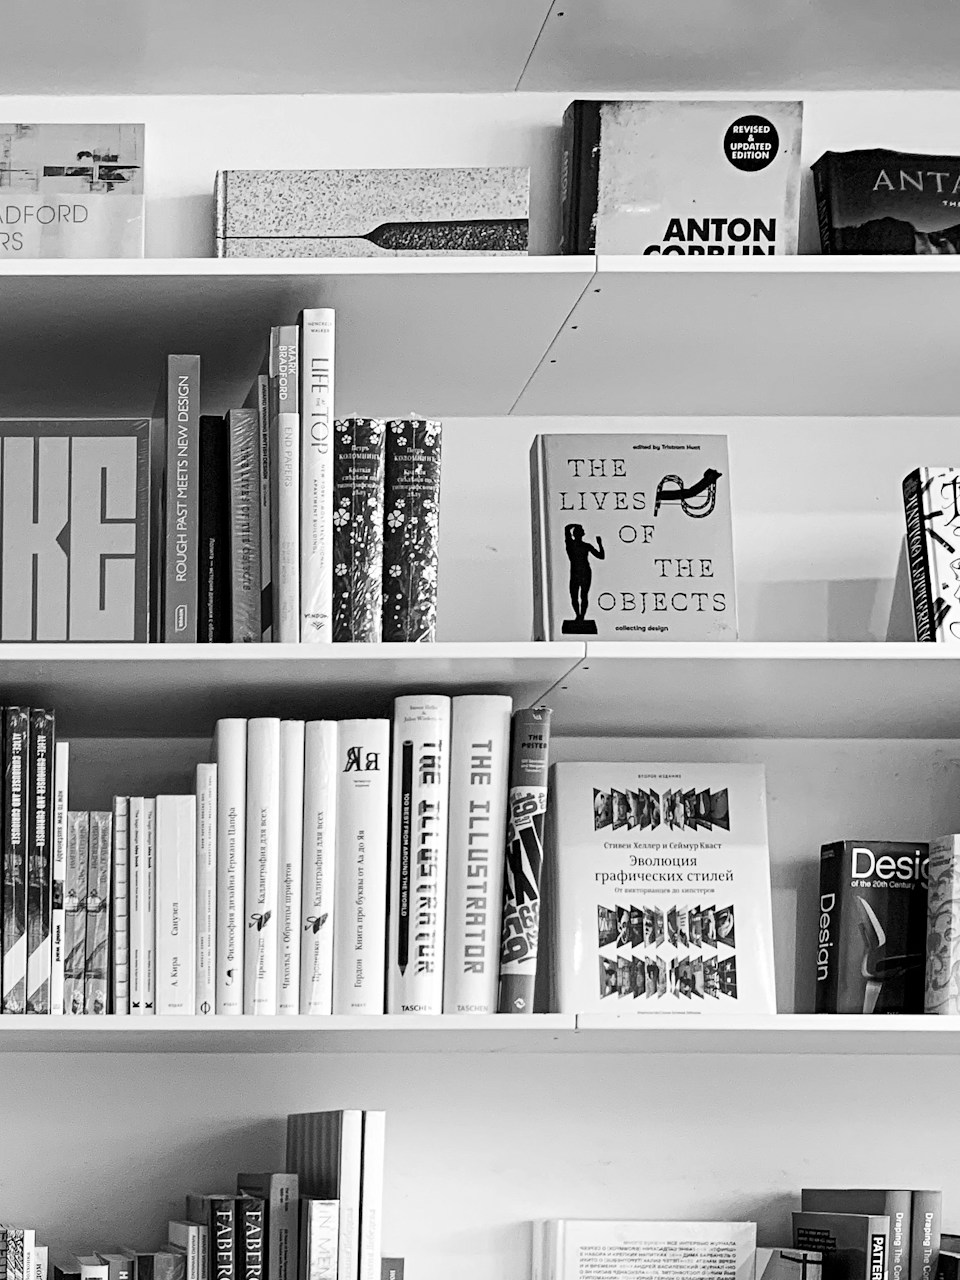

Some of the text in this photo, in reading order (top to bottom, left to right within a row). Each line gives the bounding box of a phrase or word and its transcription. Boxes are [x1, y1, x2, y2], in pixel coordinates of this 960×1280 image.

[732, 125, 771, 134] REVISED
[747, 134, 756, 143] &
[730, 142, 772, 152] UPDATED
[731, 151, 770, 160] EDITION
[662, 217, 777, 242] ANTON
[567, 458, 627, 477] THE
[175, 375, 190, 582] ROUGH PAST MEETS NEW DESIGN
[559, 491, 646, 511] LIVES
[618, 524, 655, 544] OF
[654, 558, 714, 578] THE
[597, 592, 726, 614] OBJECTS
[463, 739, 492, 974] THE ILLUSTRATOR
[629, 855, 697, 867] Эволюция
[595, 869, 734, 885] графических стилей
[816, 892, 836, 981] Design
